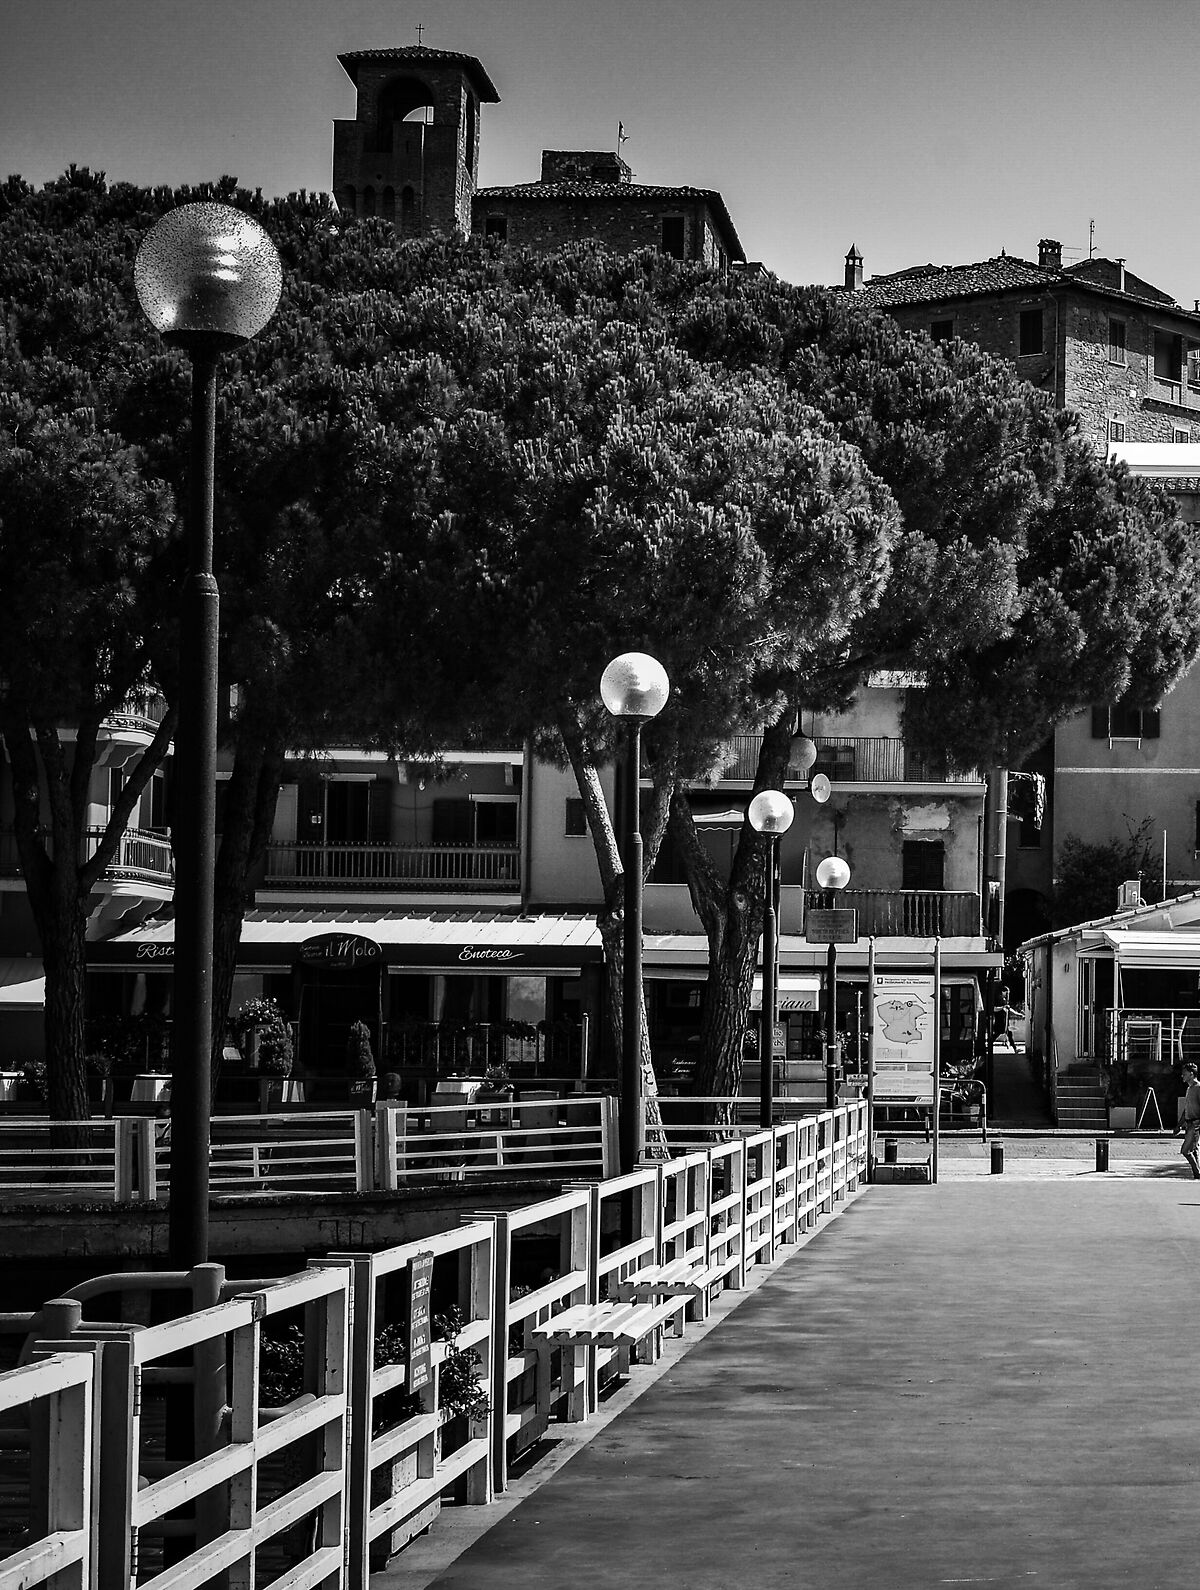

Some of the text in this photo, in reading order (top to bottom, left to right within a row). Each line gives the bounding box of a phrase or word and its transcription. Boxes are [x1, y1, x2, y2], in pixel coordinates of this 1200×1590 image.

[136, 942, 175, 958] Rist
[338, 937, 376, 966] Molo
[458, 945, 524, 961] Enoteca
